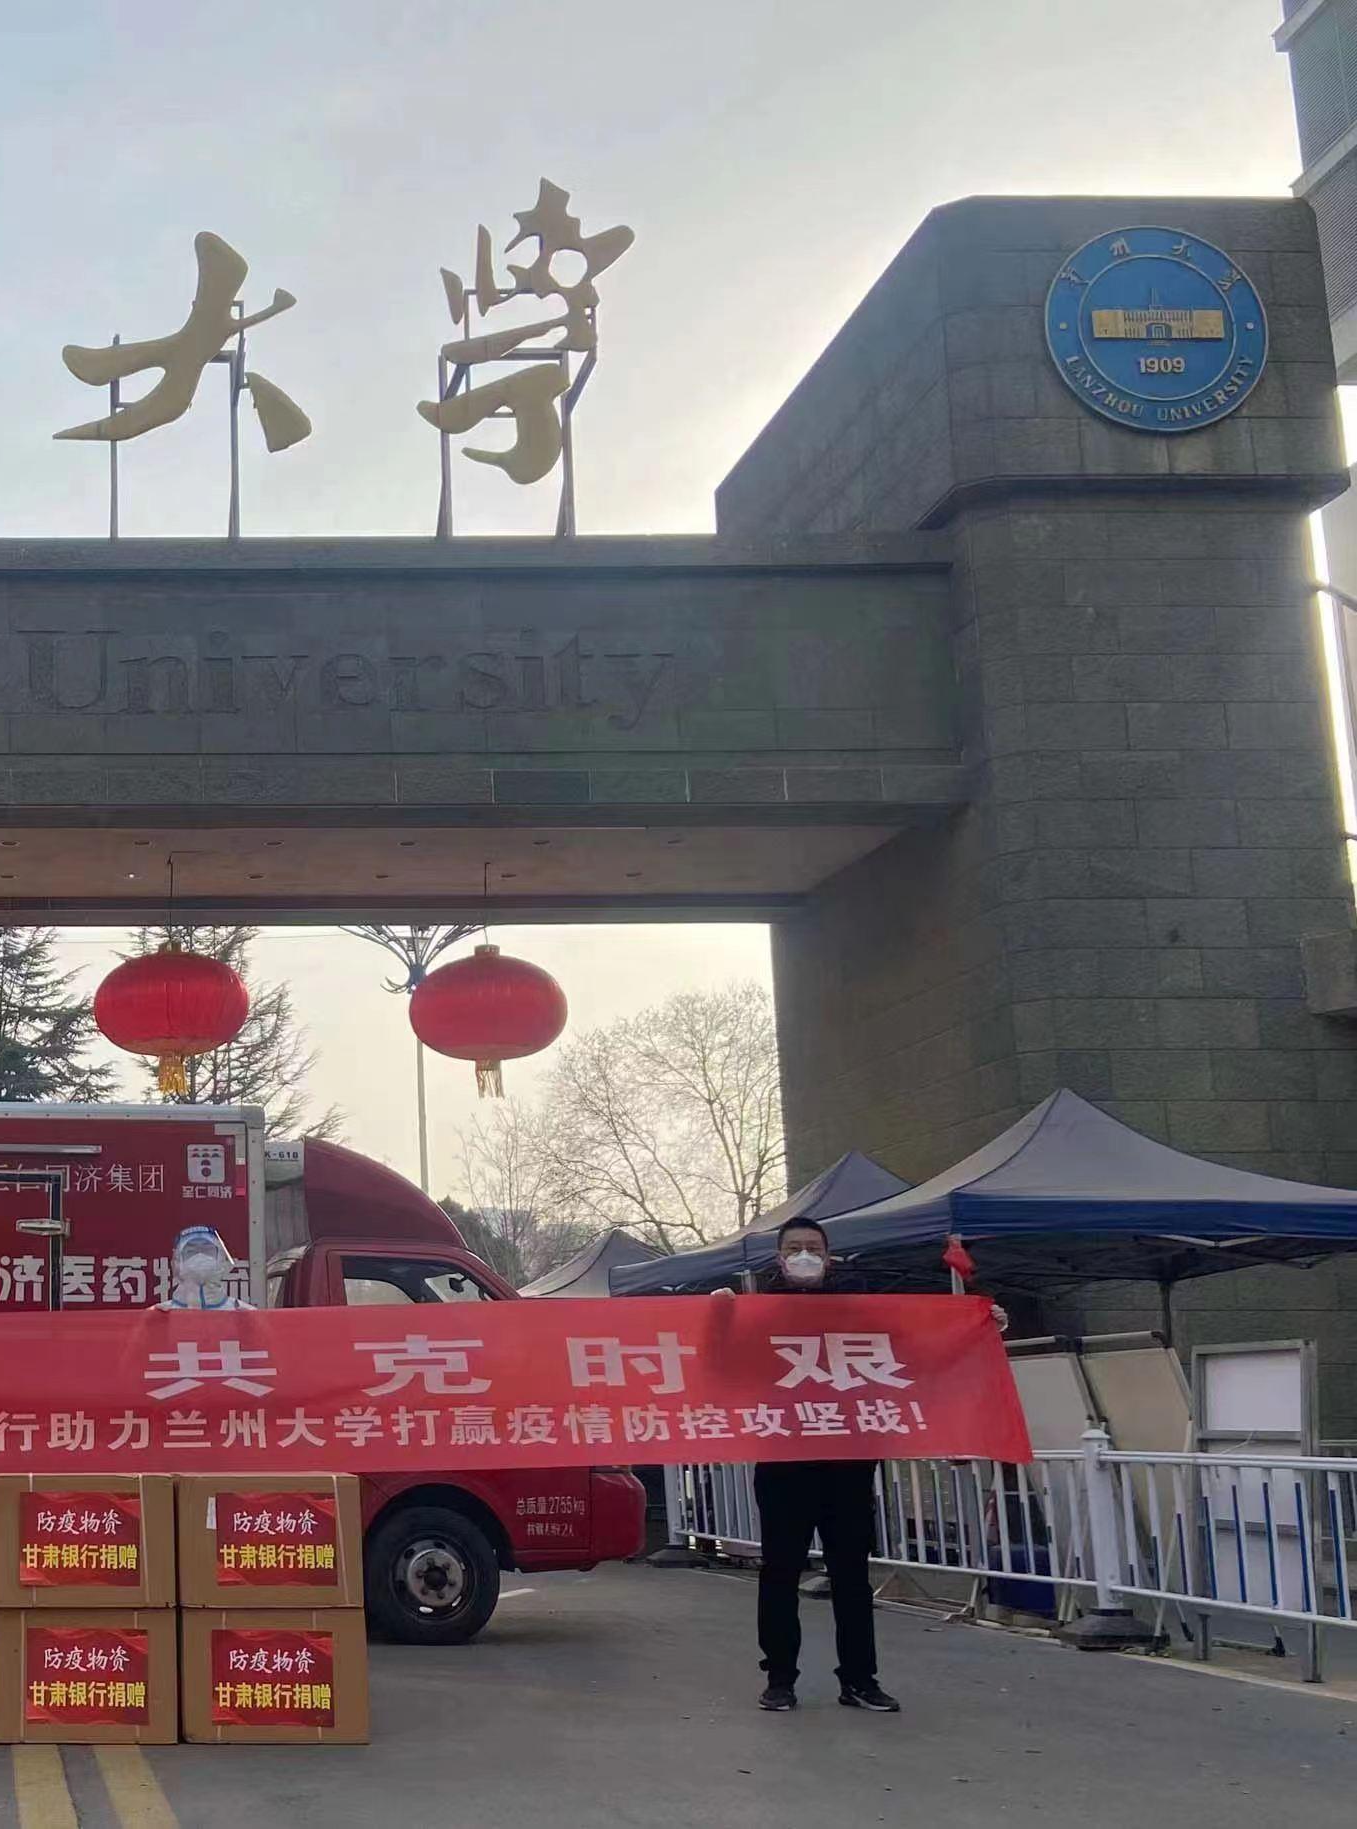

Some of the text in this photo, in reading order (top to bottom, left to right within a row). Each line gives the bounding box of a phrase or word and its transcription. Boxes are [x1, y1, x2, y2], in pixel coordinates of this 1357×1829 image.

[1138, 357, 1187, 374] 1909
[1065, 355, 1254, 422] LANZHOU UNIVERSITY
[16, 628, 675, 730] University
[38, 1508, 122, 1536] 防疫物资
[233, 1509, 318, 1536] 防疫物资
[22, 1543, 138, 1571] 甘肃银行捐赠
[219, 1543, 335, 1570] 甘肃银行捐赠
[44, 1645, 131, 1672] 防疫物资
[229, 1647, 316, 1674] 防疫物资
[29, 1680, 147, 1708] 甘肃银行捐赠
[214, 1682, 332, 1710] 甘肃银行捐赠
